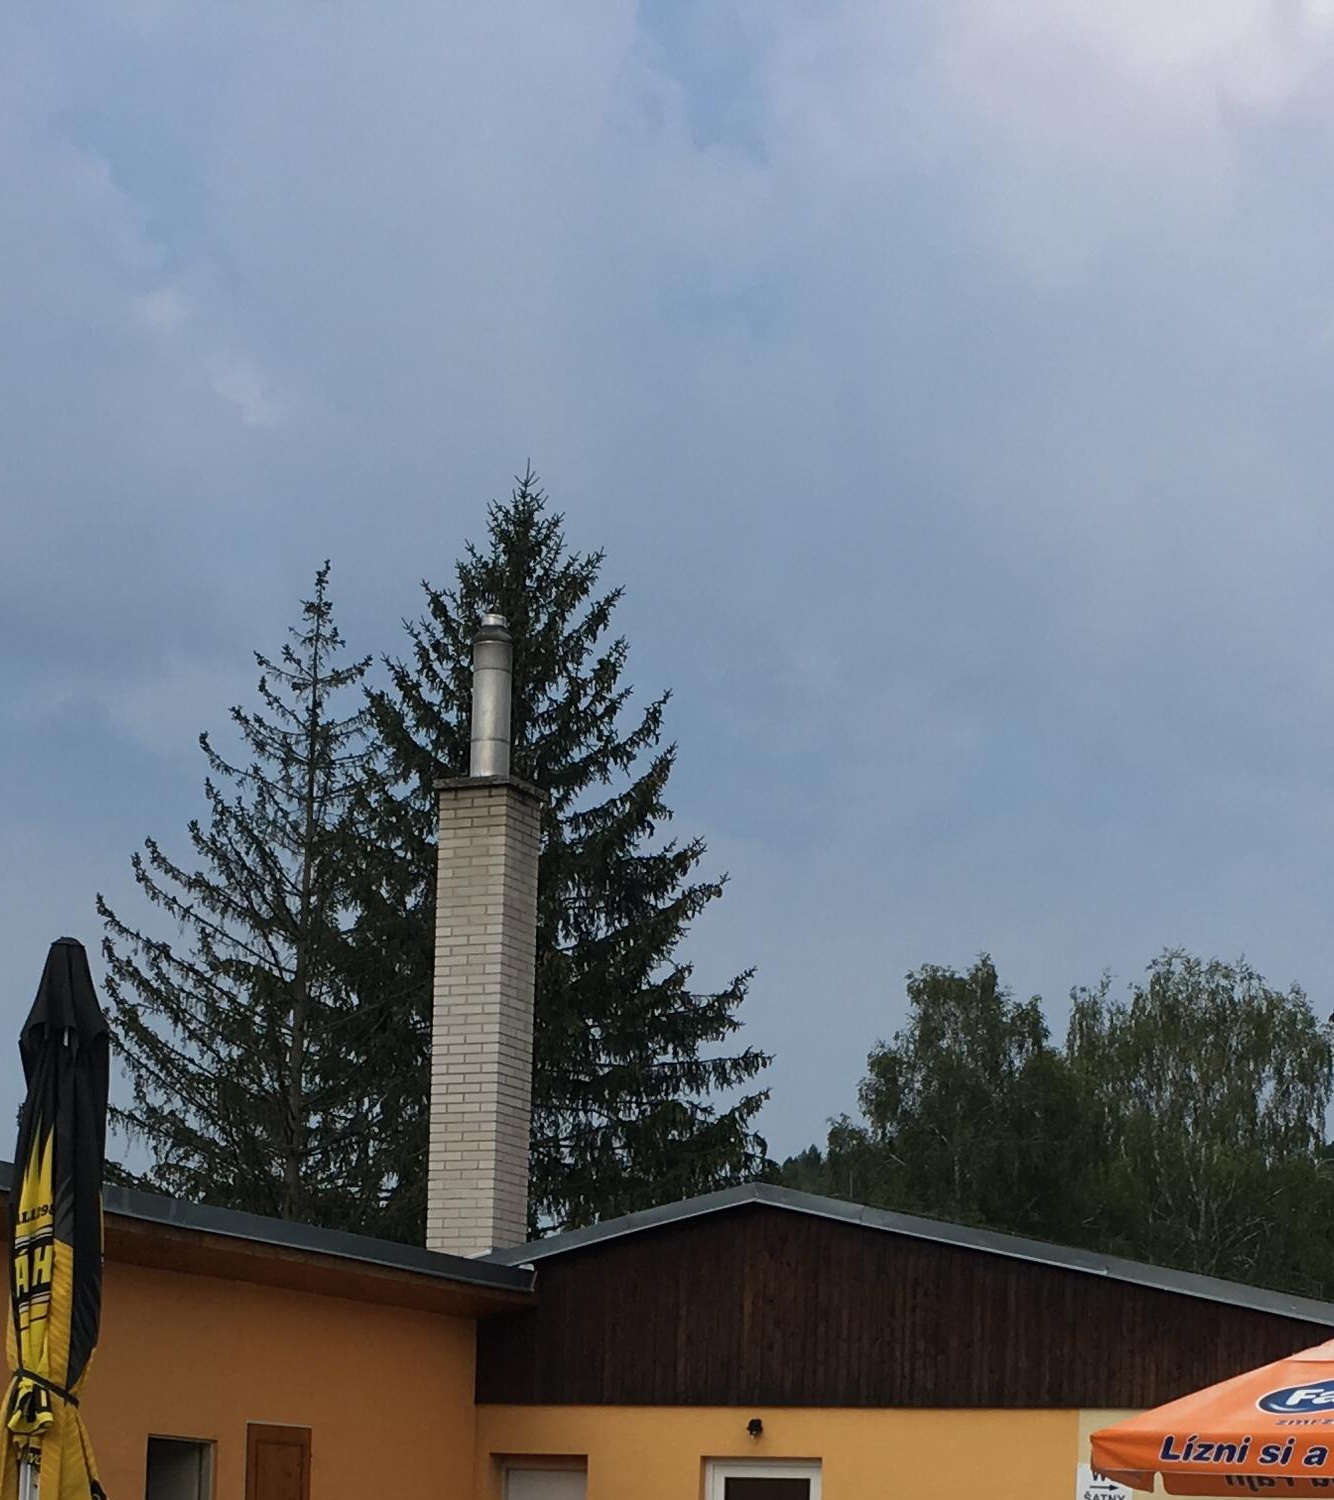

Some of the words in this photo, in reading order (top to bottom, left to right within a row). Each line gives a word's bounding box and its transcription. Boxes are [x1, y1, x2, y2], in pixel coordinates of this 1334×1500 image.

[1160, 1434, 1252, 1464] Lízni
[1258, 1438, 1296, 1465] si
[1303, 1446, 1328, 1468] a
